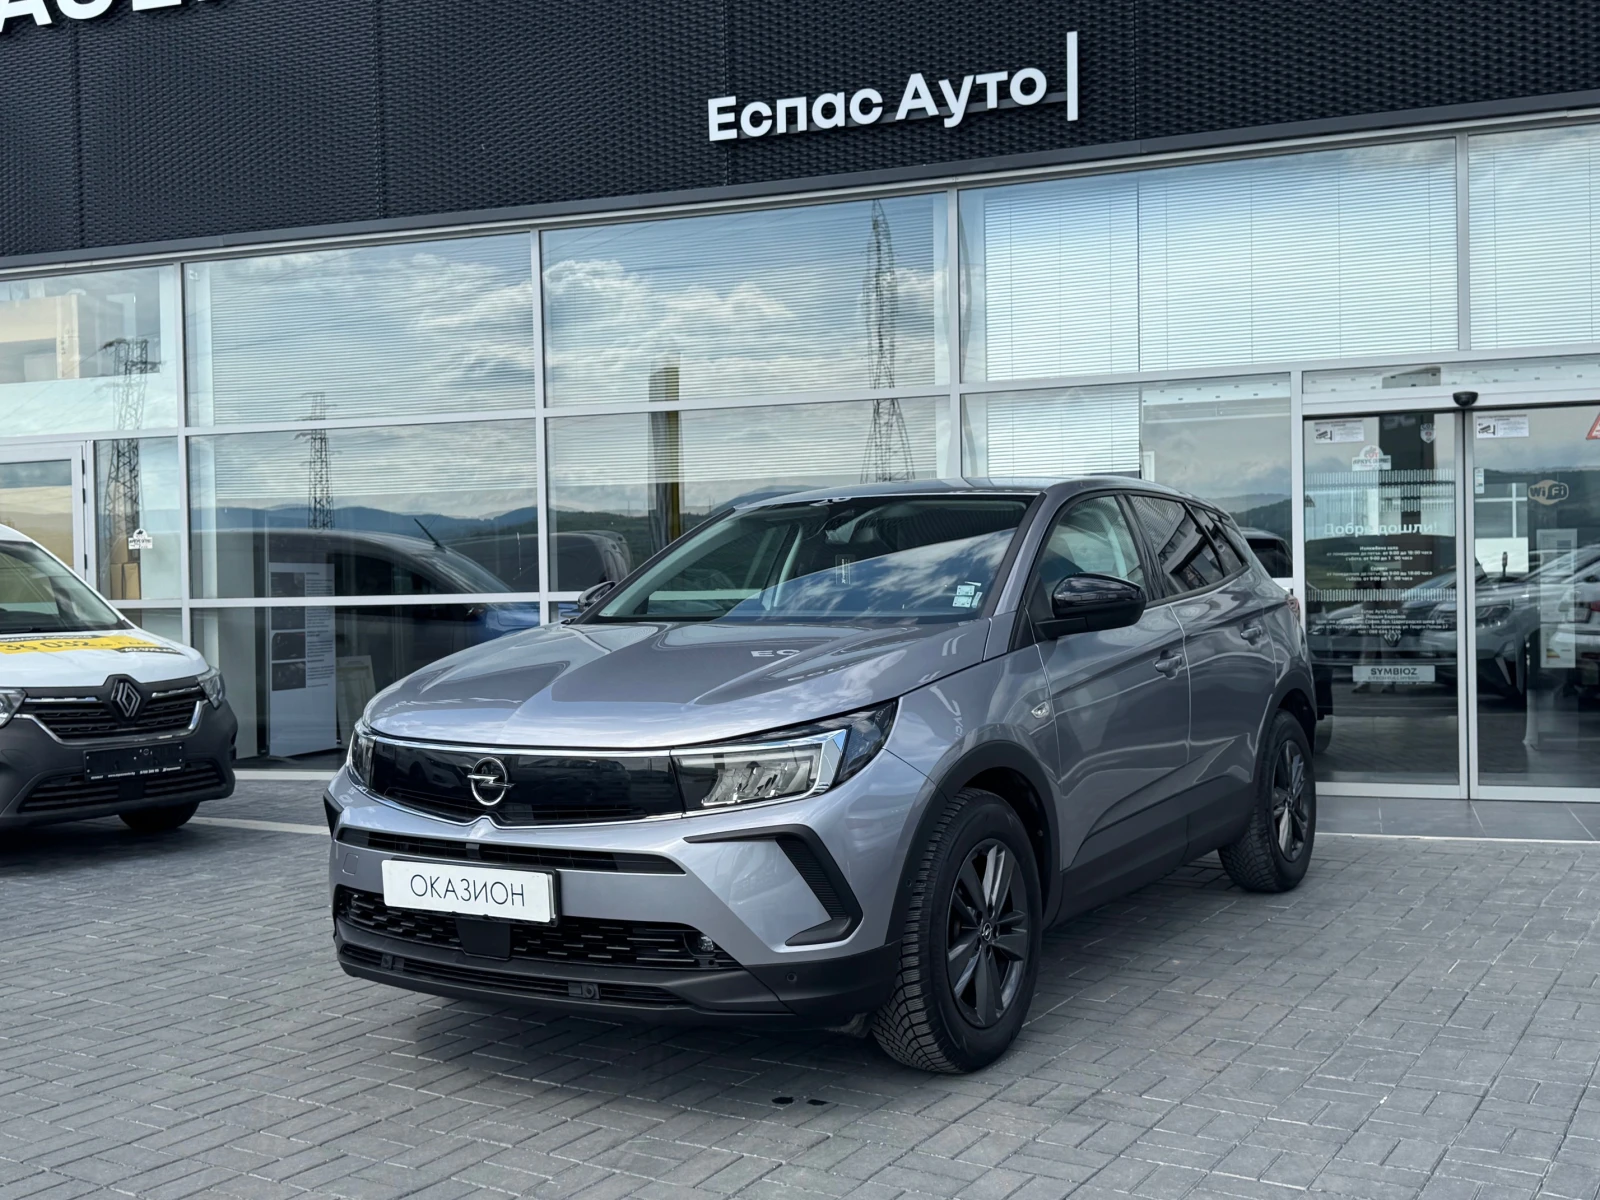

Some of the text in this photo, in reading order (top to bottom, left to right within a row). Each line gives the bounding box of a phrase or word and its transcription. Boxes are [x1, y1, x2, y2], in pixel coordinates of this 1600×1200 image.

[707, 67, 1047, 141] Еспас Ауто
[1370, 667, 1418, 676] SYMBIOZ
[410, 874, 525, 907] ОКАЗИОН
